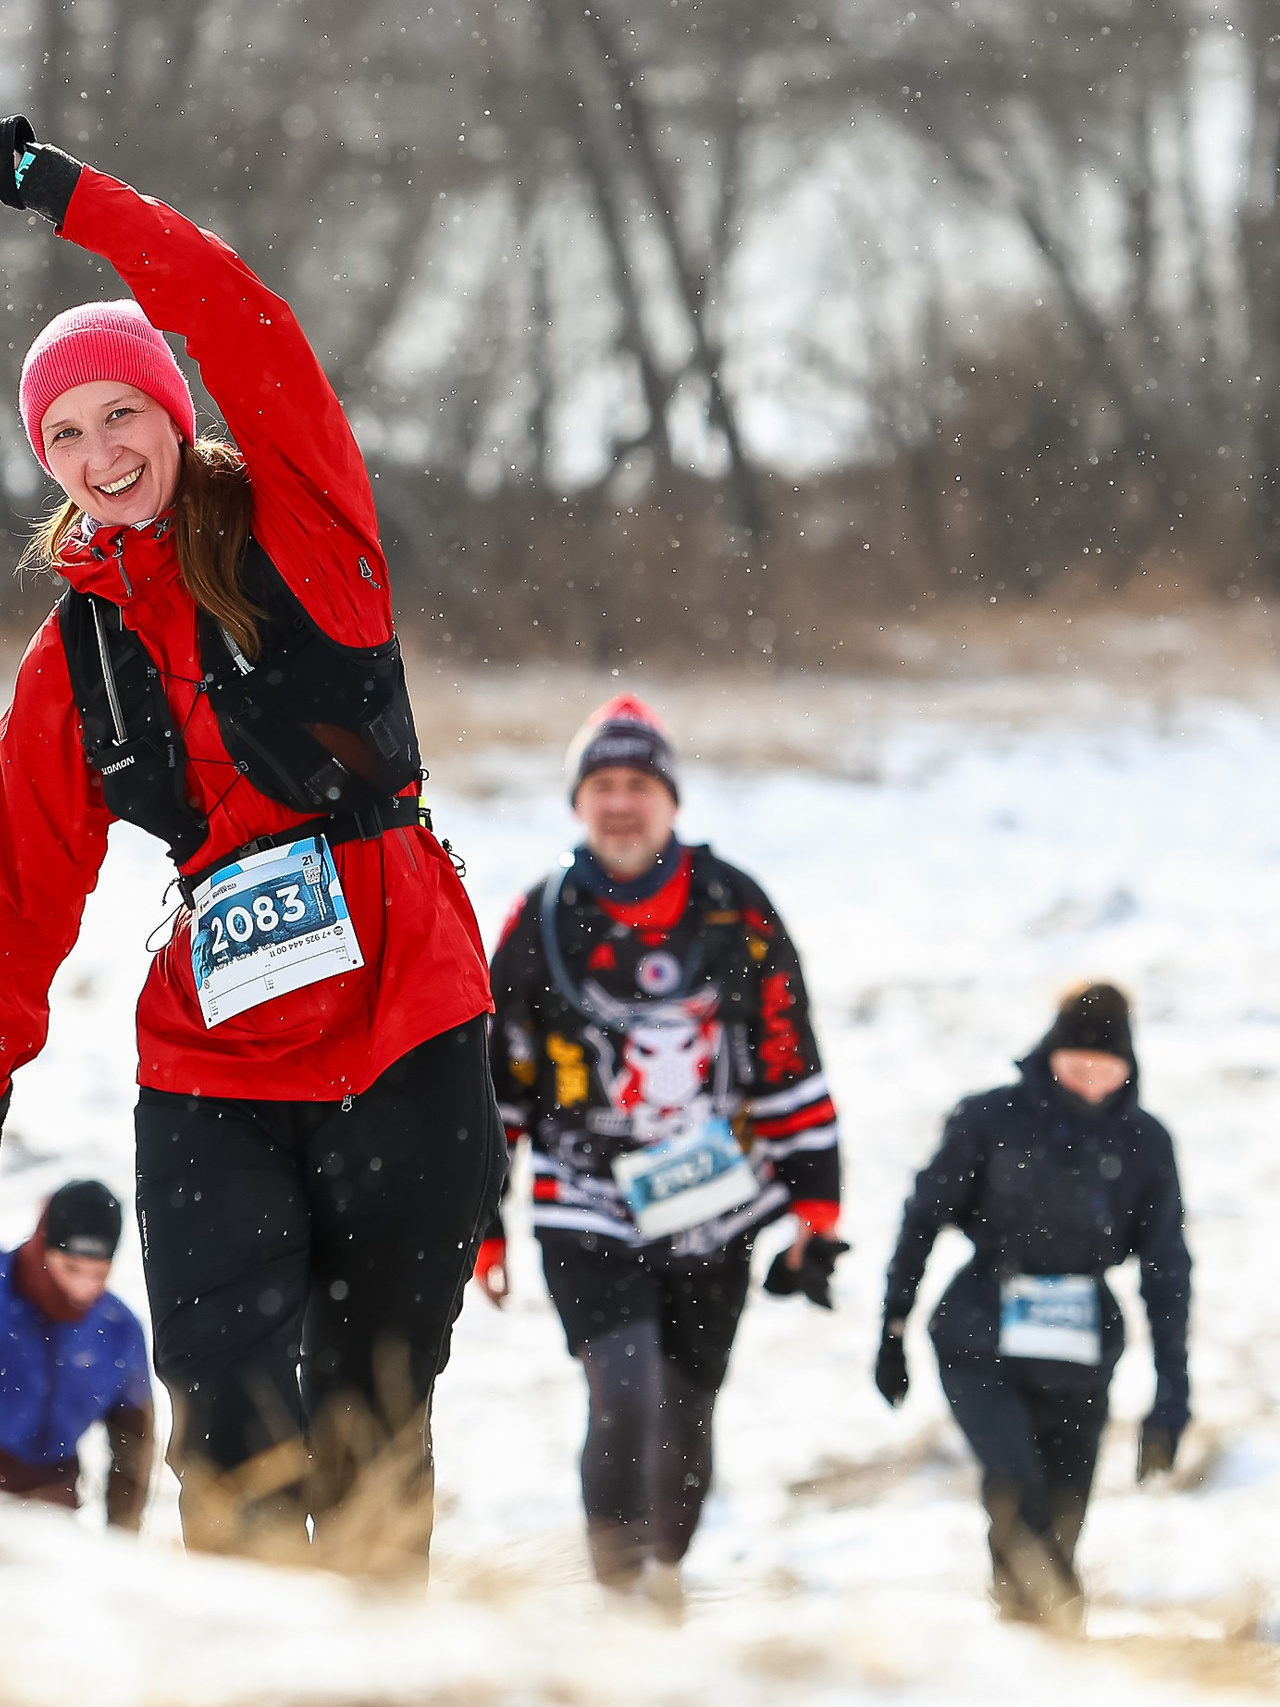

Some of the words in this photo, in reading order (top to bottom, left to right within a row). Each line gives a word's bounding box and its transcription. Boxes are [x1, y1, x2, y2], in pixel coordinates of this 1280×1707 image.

[301, 854, 314, 867] 21
[210, 883, 307, 955] 2083
[305, 933, 321, 945] 925
[322, 930, 332, 940] +7
[276, 945, 288, 954] 00
[288, 940, 304, 951] 444
